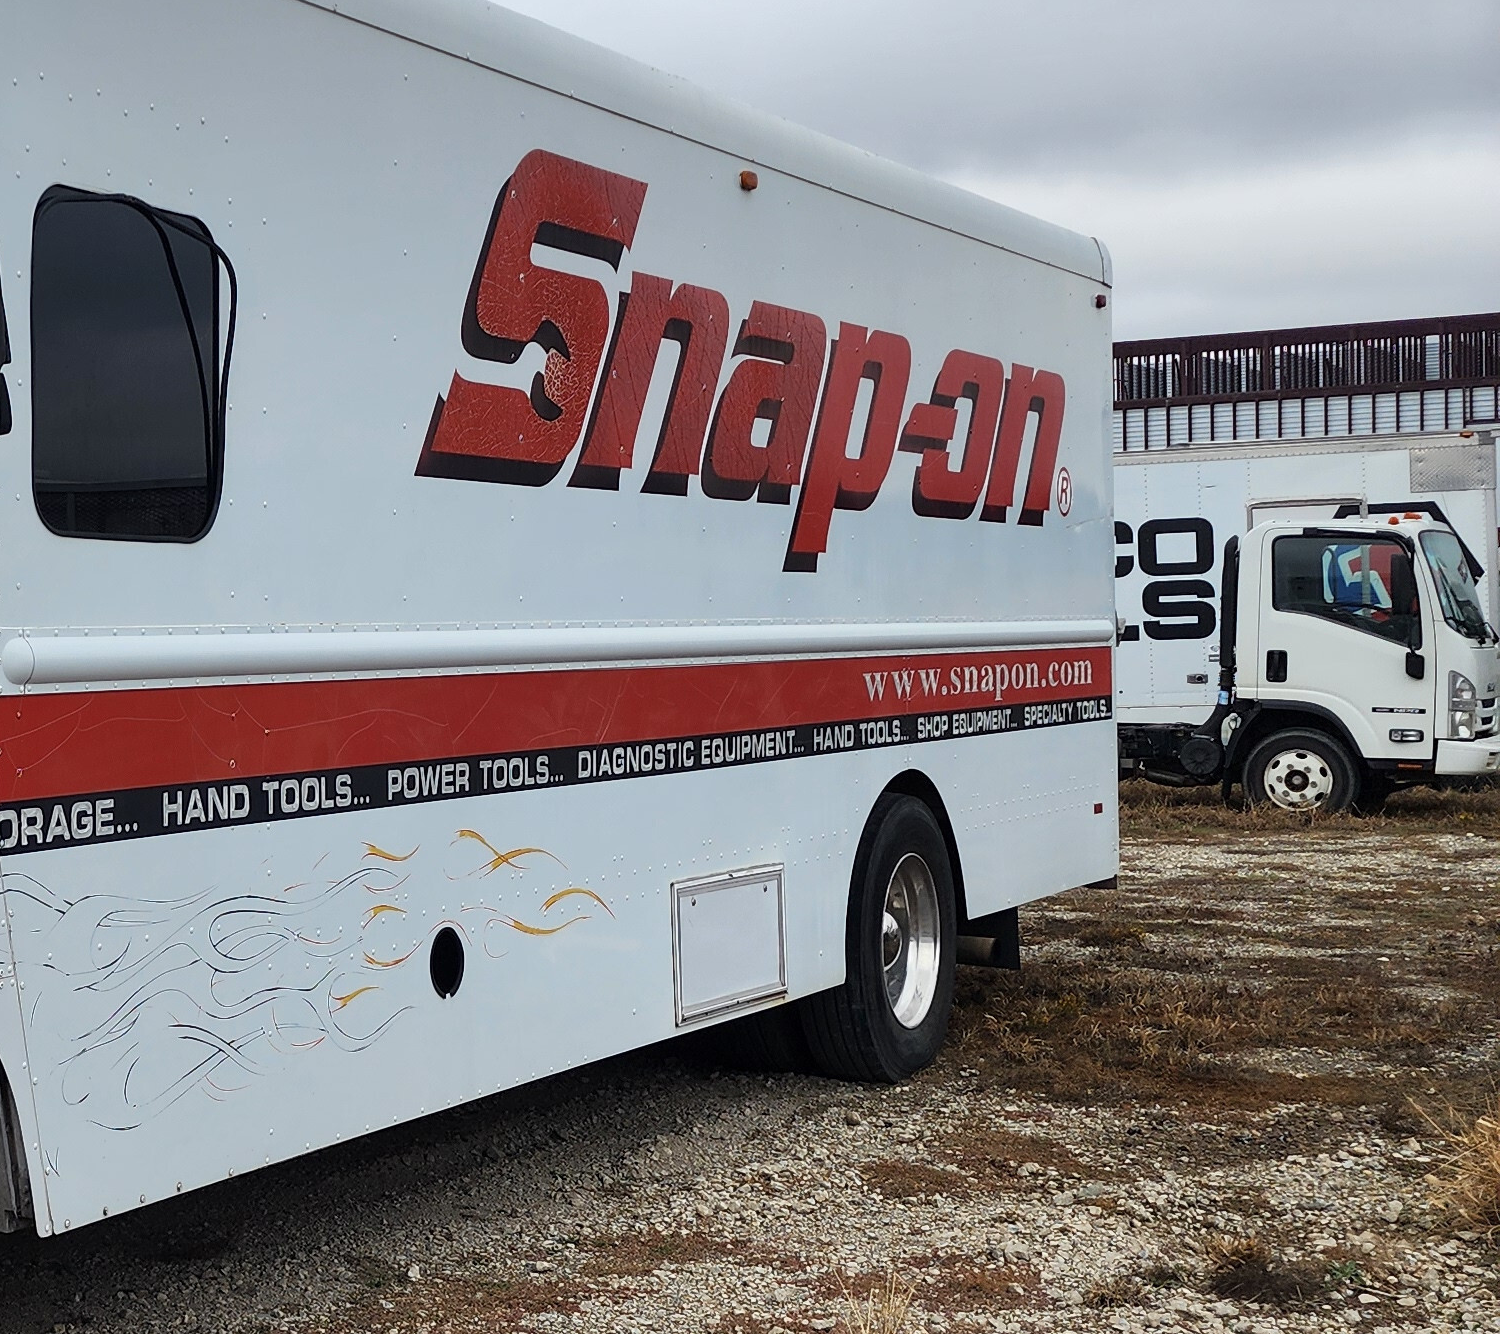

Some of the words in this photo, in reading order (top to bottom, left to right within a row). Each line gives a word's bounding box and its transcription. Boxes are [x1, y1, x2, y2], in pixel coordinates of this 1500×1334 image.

[414, 148, 1066, 573] Snap-on
[862, 658, 1093, 701] www.snapon.com
[162, 784, 250, 827] HAND
[263, 774, 370, 815] TOOLS...
[387, 762, 470, 801] POWER
[480, 755, 565, 791] TOOLS...
[577, 740, 695, 779] DIAGNOSTIC
[700, 729, 805, 765] EQUIPMENT...
[813, 724, 855, 752] HAND
[859, 719, 910, 745] TOOLS...
[917, 714, 949, 739] SHOP
[1023, 701, 1074, 727] SPECIALTY
